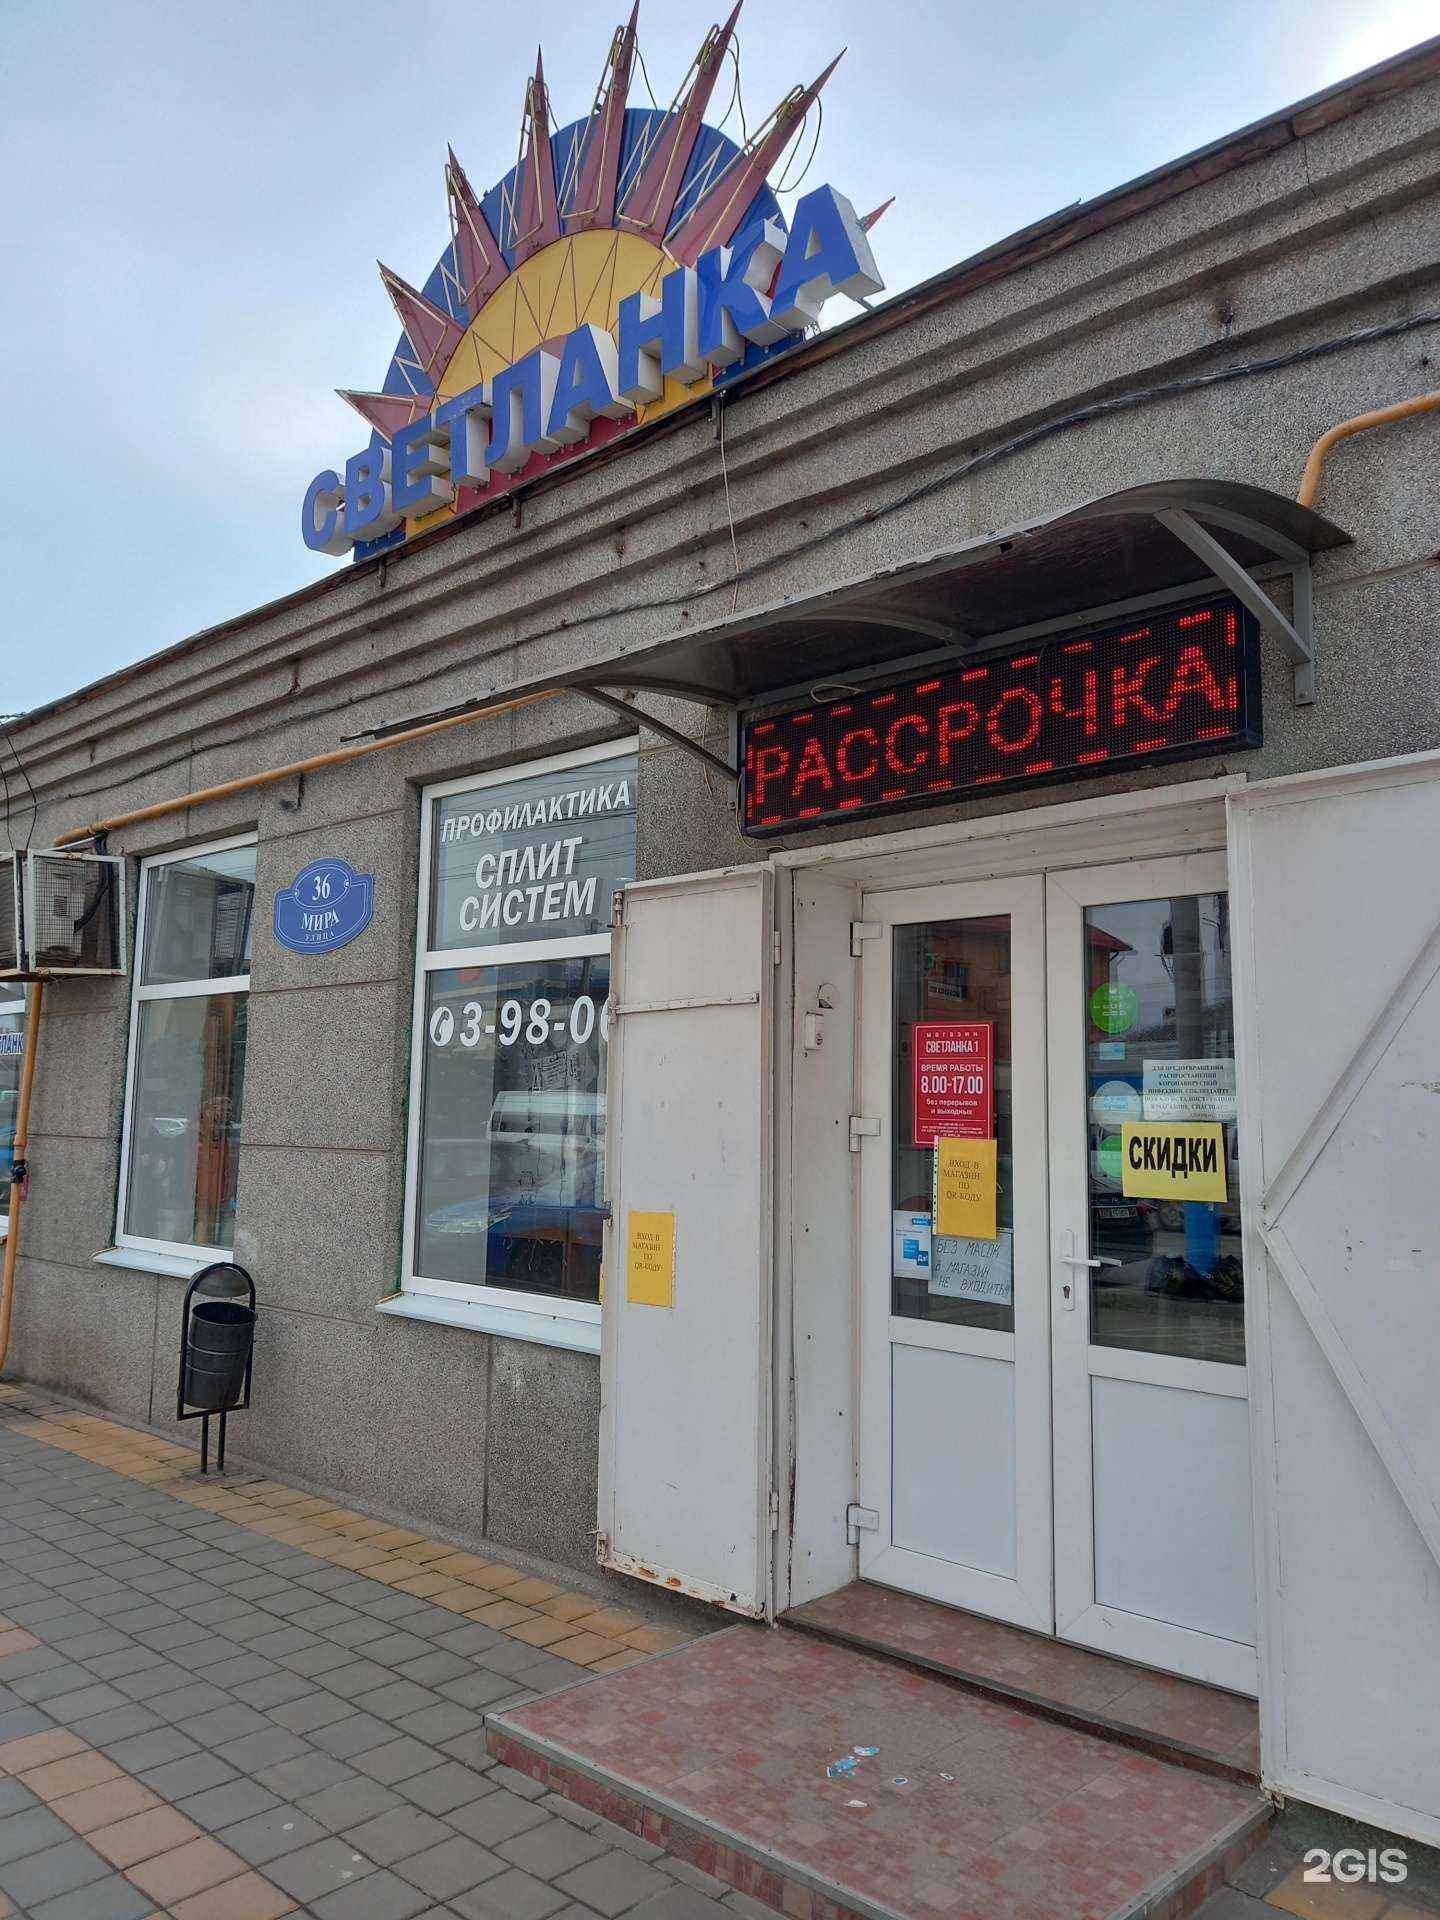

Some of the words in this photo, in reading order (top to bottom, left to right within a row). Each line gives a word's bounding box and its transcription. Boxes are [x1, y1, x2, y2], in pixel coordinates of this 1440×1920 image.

[301, 183, 885, 556] СВЕТЛАНКА
[754, 645, 1222, 805] РАССРОЧКА
[441, 780, 631, 843] ПРОФИЛАКТИКА
[475, 836, 583, 890] СПЛИТ
[312, 873, 332, 901] 36
[459, 877, 597, 932] СИСТЕМ
[302, 908, 340, 931] МИРА
[926, 1040, 973, 1053] СВЕТЛАНКА
[975, 1041, 979, 1053] 1
[921, 1064, 948, 1072] ВРЕМЯ
[949, 1064, 983, 1072] РАБОТЫ
[921, 1075, 983, 1095] 8.00-17.00
[949, 1159, 970, 1169] ВХОД
[974, 1161, 979, 1169] В
[1129, 1136, 1217, 1179] СКИДКИ
[943, 1169, 980, 1180] МАГАЗИН
[958, 1181, 970, 1189] ПО
[946, 1190, 981, 1202] QR-КОДУ
[632, 1241, 661, 1251] МАГАЗИН
[936, 1239, 958, 1254] БЕЗ
[965, 1242, 1000, 1257] МАСОК
[946, 1261, 990, 1278] МАГАЗИН
[938, 1275, 951, 1288] НЕ
